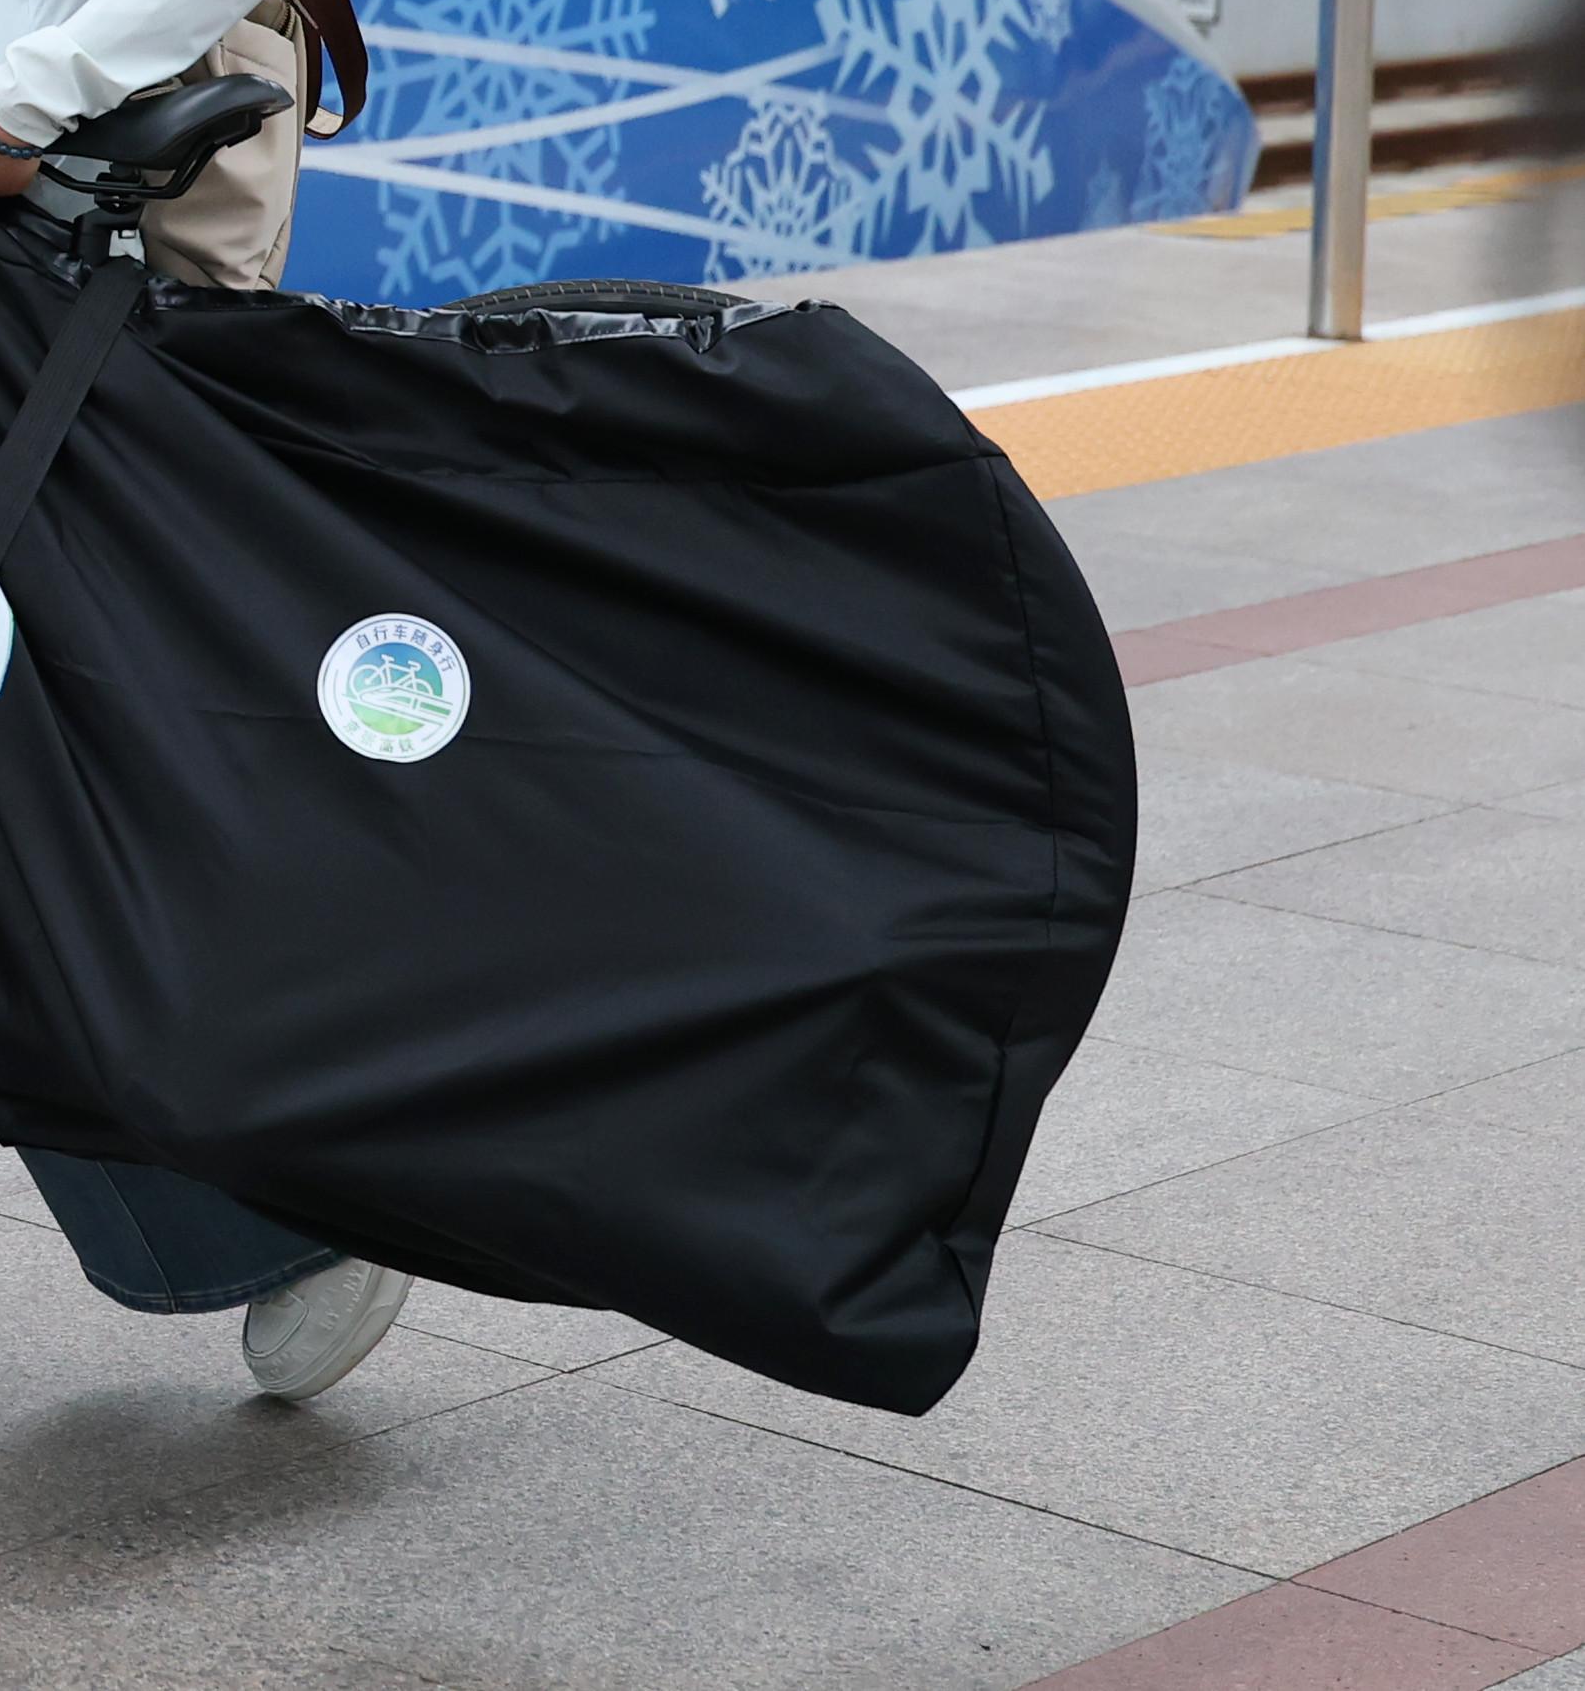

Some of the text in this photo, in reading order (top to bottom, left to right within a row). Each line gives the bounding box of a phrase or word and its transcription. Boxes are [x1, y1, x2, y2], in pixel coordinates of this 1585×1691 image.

[356, 624, 456, 673] 自行车随身行
